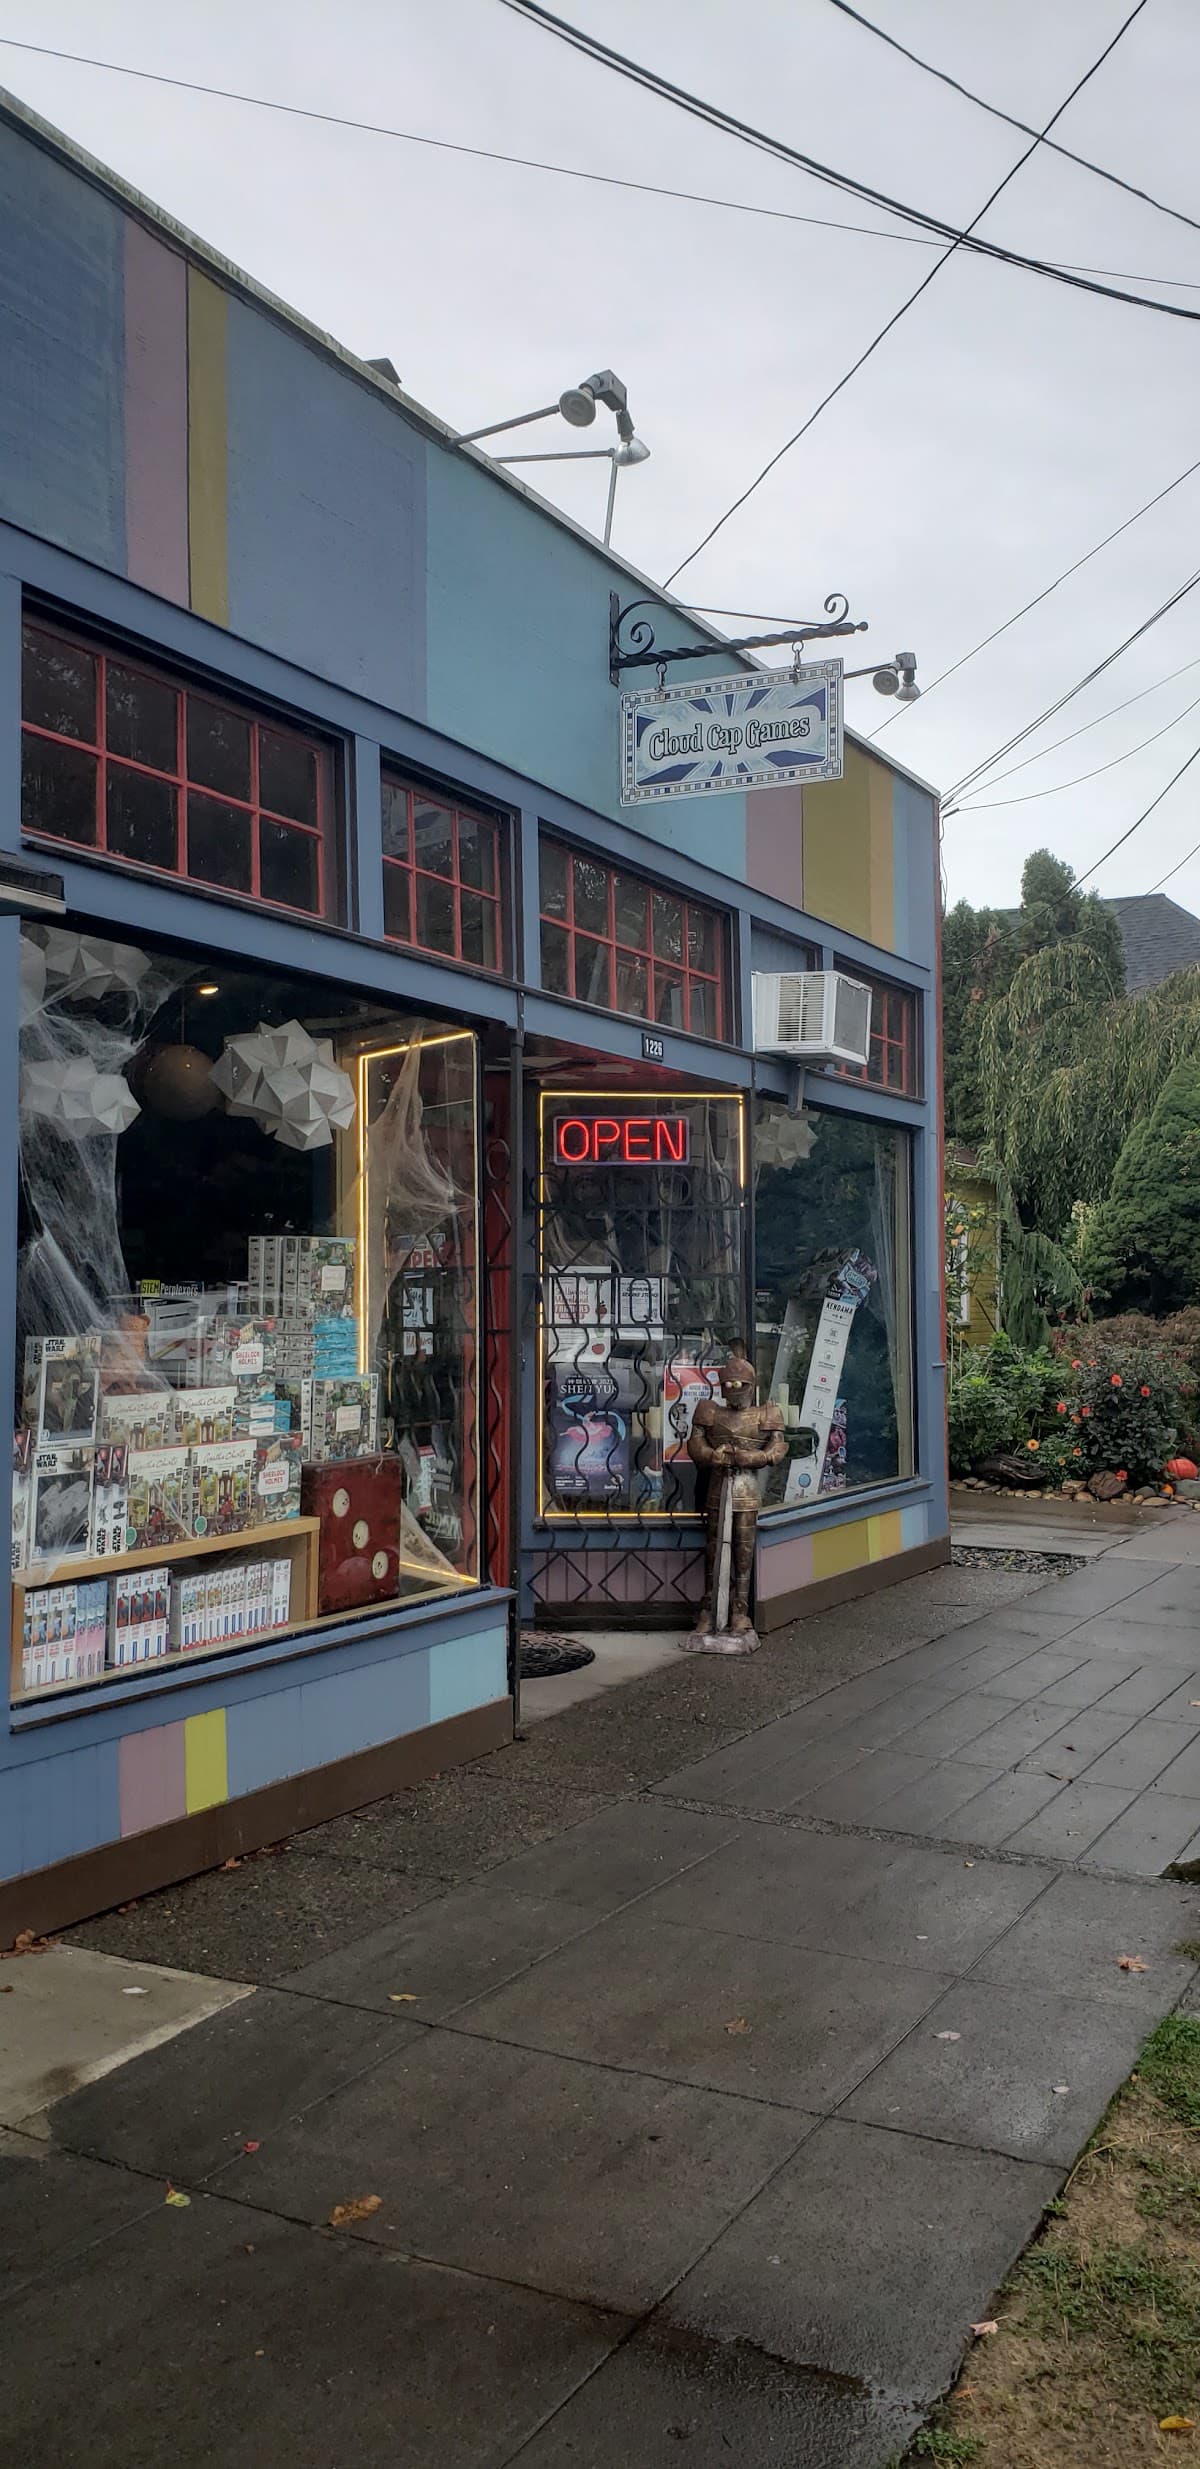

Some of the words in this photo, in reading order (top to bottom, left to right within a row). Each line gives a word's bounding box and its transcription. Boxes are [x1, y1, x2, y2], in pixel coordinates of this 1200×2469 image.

[649, 723, 703, 761] Cloud
[707, 724, 742, 755] Cap
[746, 717, 810, 749] Games
[559, 1119, 683, 1161] OPEN
[143, 1282, 159, 1294] STEM
[826, 1301, 853, 1314] KENDAMA
[235, 1351, 260, 1359] SHERLOCK
[38, 1453, 57, 1461] STAR
[36, 1460, 56, 1468] WARS
[262, 1469, 286, 1478] SHERLOCK
[264, 1477, 283, 1485] HOLMES
